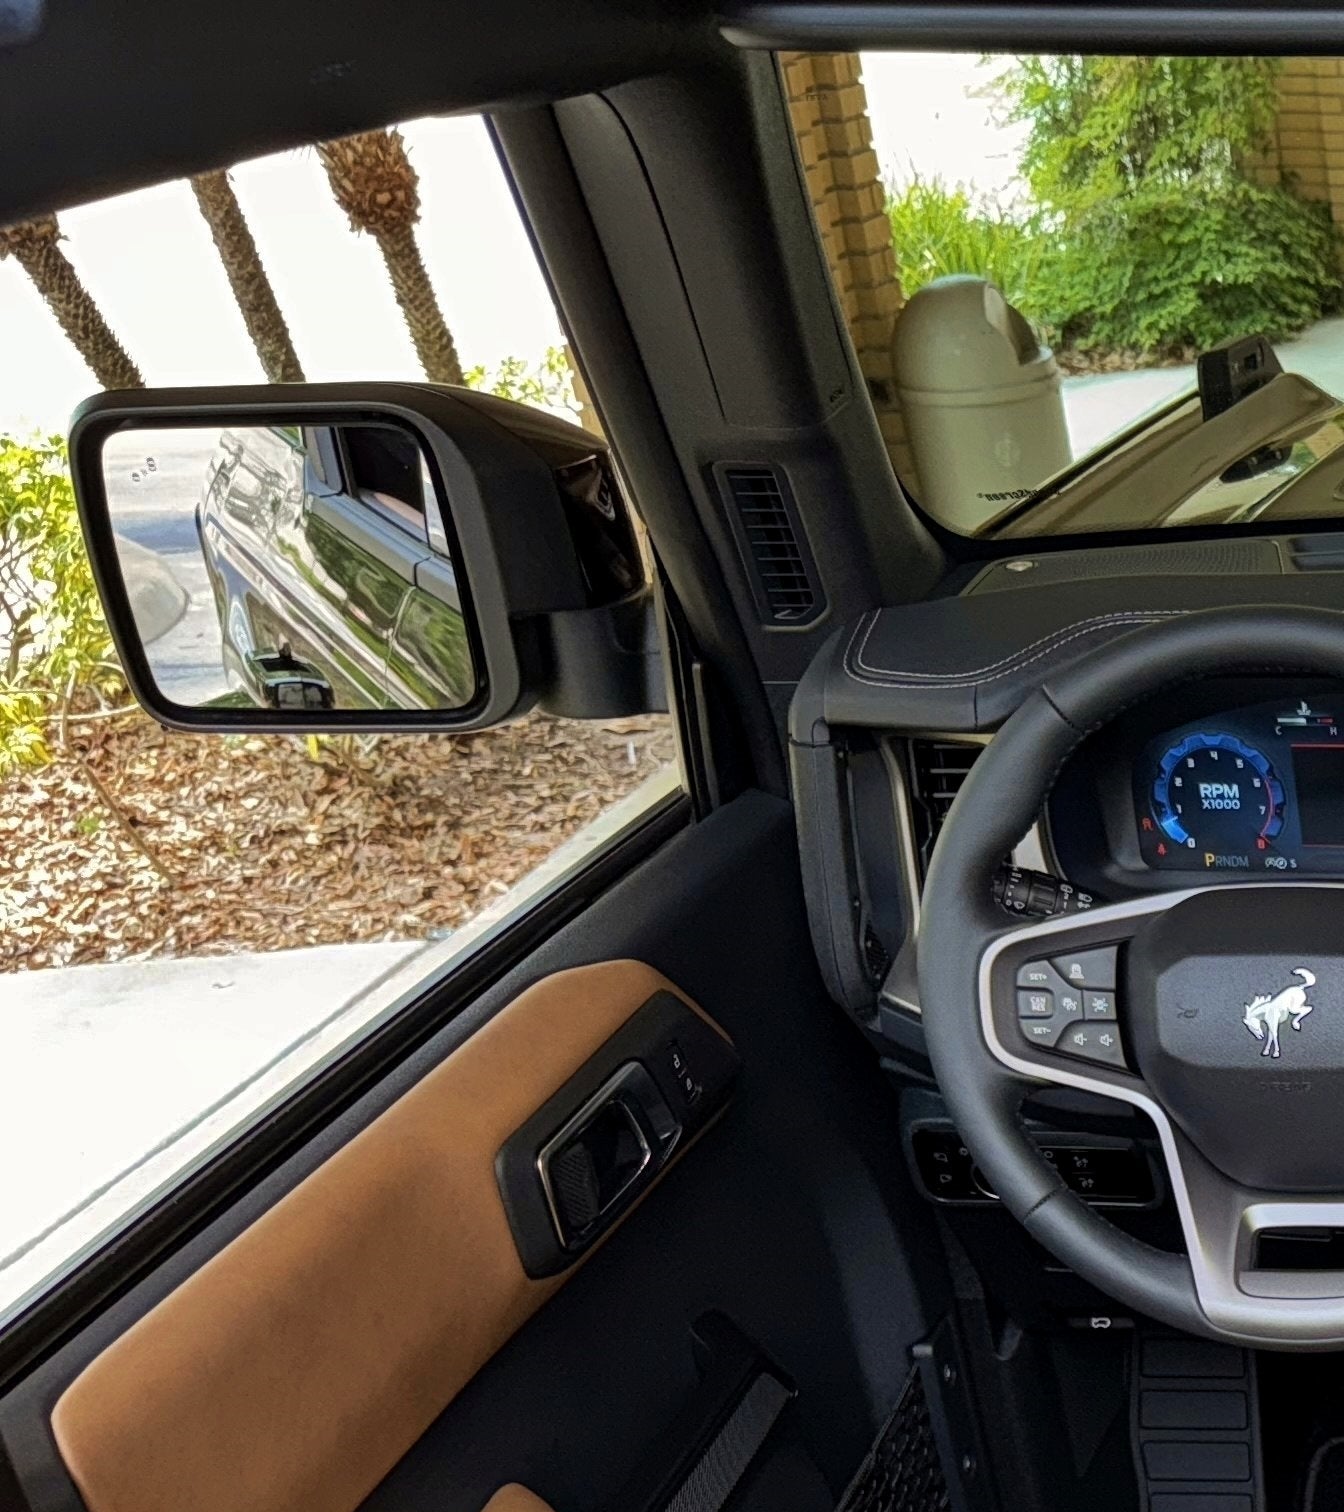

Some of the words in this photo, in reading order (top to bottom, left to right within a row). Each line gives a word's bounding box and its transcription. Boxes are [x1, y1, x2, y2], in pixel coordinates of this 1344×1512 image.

[1275, 726, 1282, 735] C
[1199, 783, 1240, 798] RPM
[1259, 806, 1266, 815] 7
[1029, 973, 1047, 981] SET+
